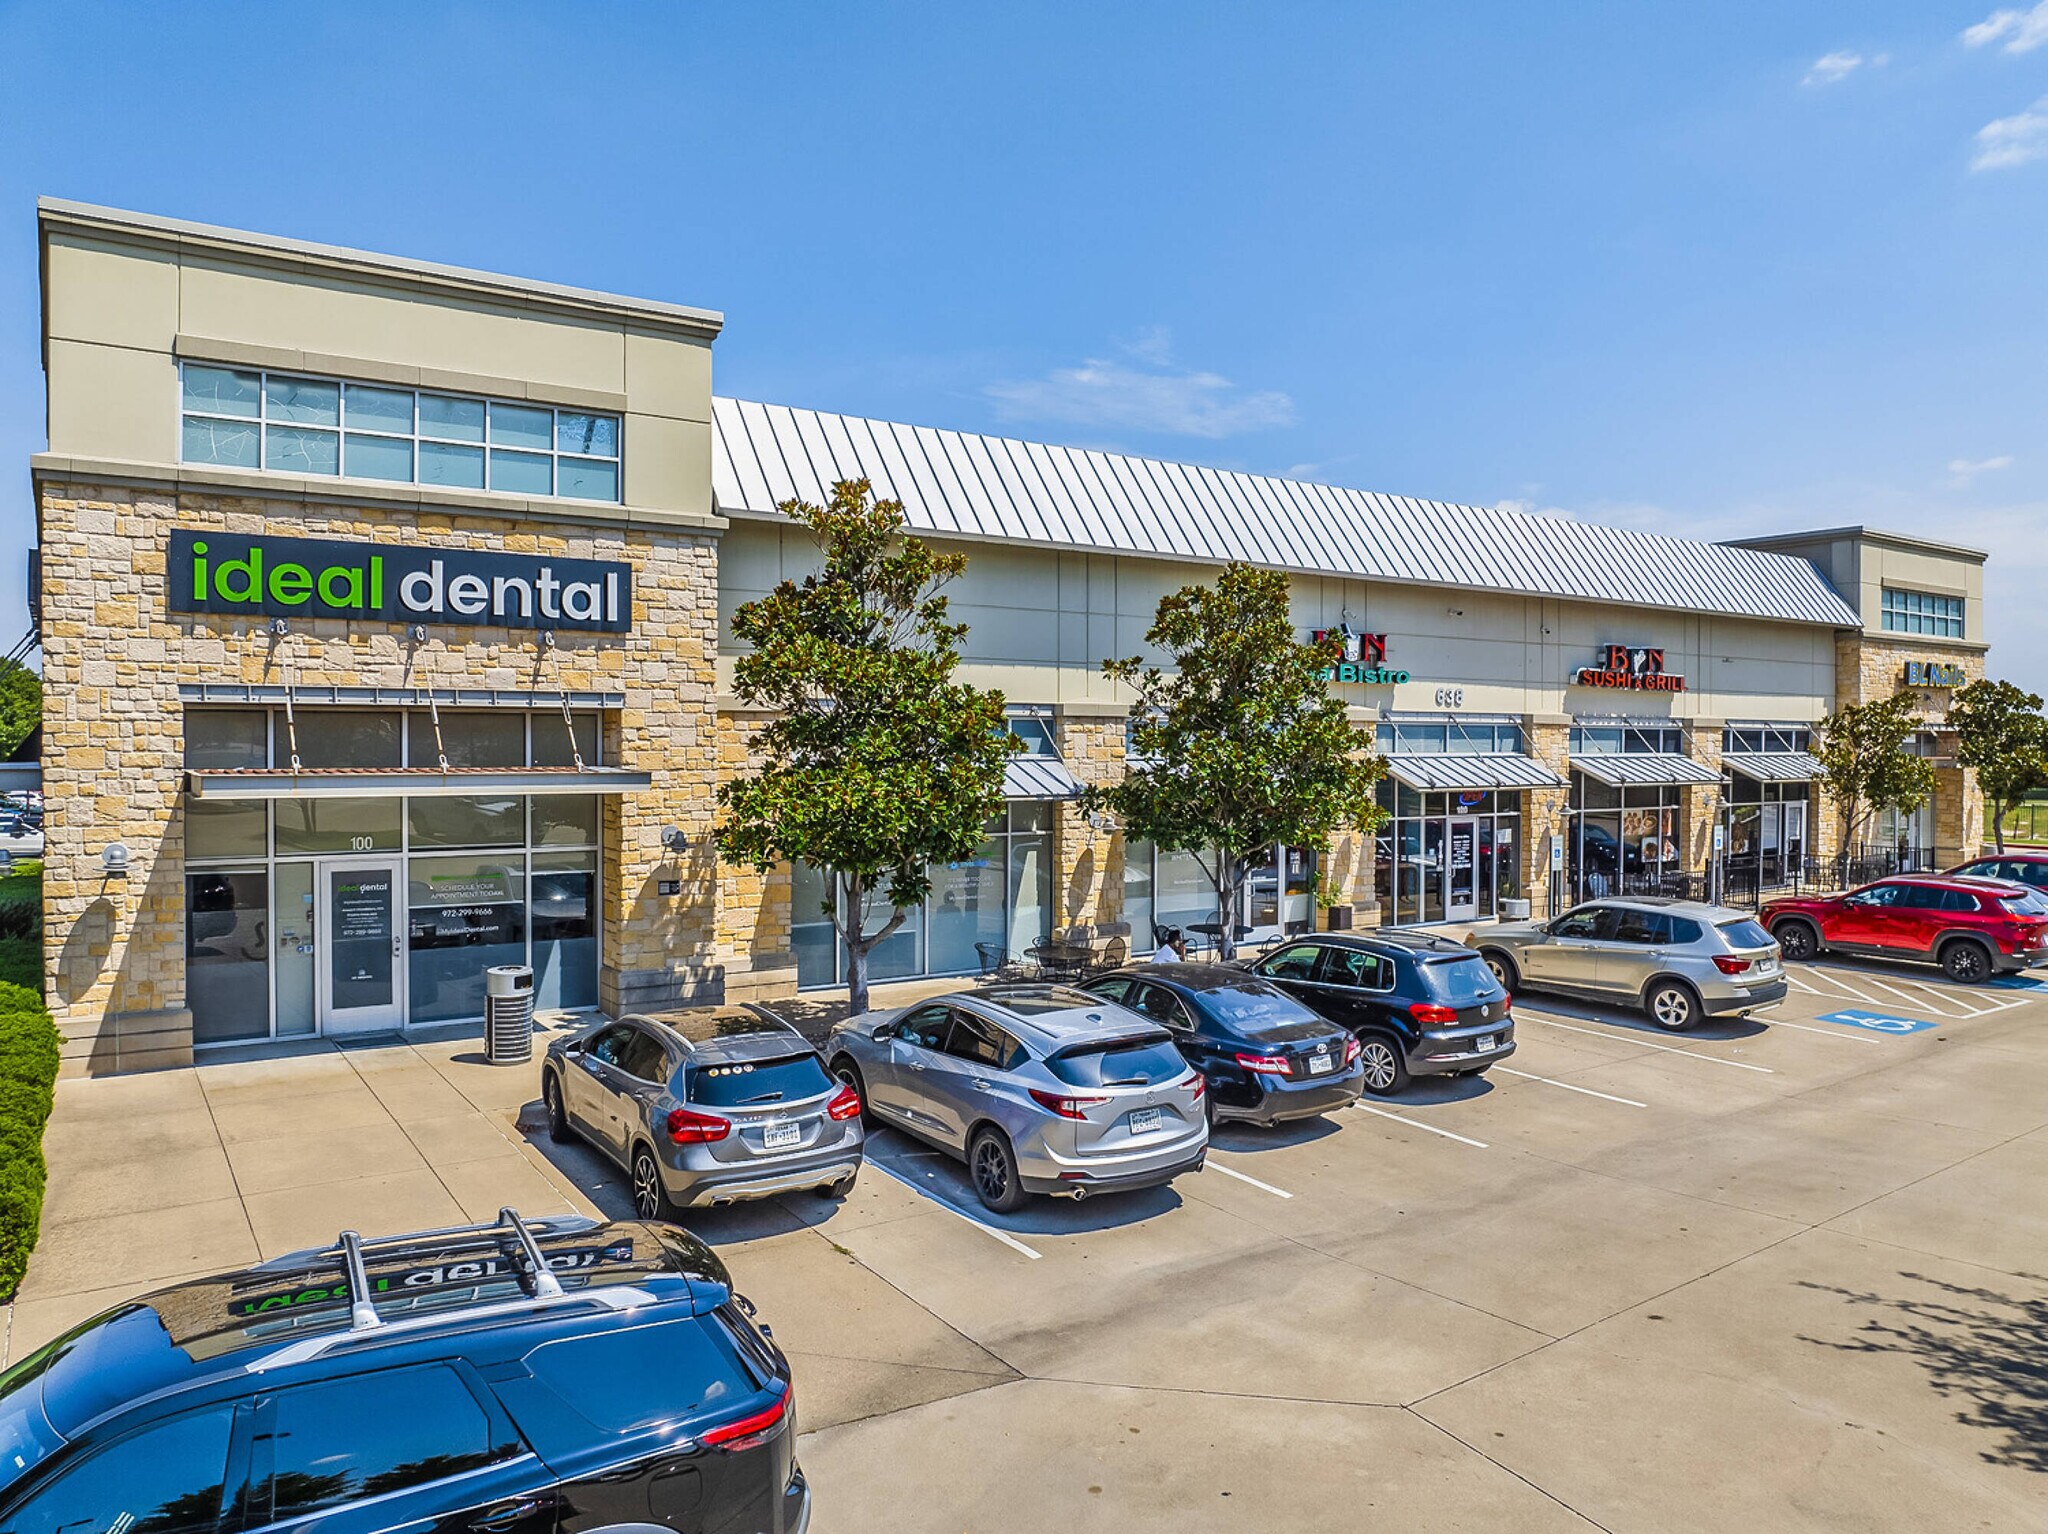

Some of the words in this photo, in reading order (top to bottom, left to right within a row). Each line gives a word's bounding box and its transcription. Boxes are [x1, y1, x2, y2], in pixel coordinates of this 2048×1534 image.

[192, 541, 383, 609] ideal
[400, 560, 618, 622] dental
[1339, 664, 1410, 684] Bistro
[1583, 671, 1632, 687] SUSHI
[1635, 677, 1643, 689] &
[1645, 675, 1687, 691] GRILL
[1908, 662, 1928, 686] BL
[1930, 663, 1966, 687] Nails
[350, 836, 373, 850] 100
[360, 883, 388, 892] dental
[431, 891, 479, 899] APPOINTMENT
[441, 908, 493, 917] 972-299-9666
